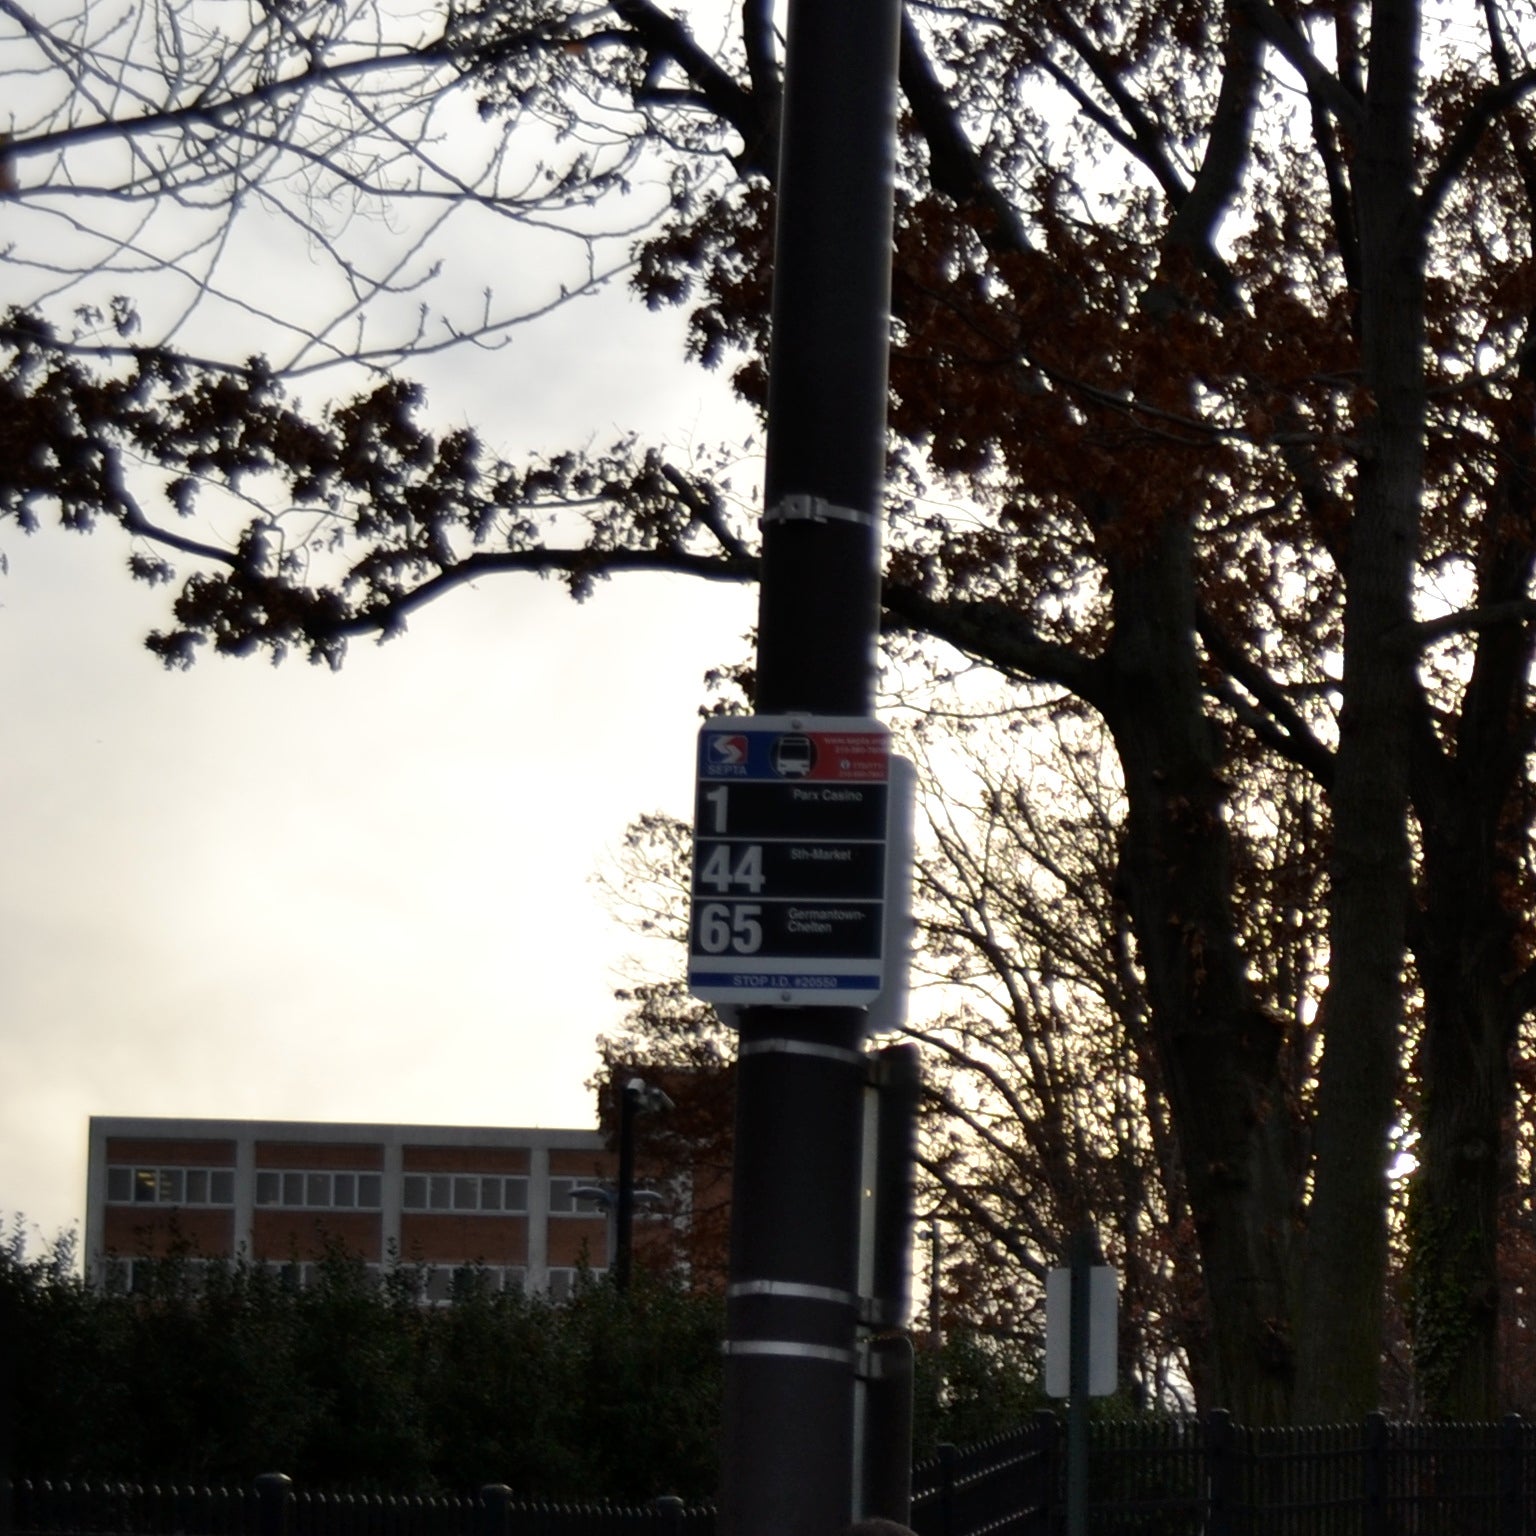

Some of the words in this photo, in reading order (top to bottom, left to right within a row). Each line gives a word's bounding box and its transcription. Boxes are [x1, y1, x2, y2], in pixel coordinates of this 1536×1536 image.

[708, 764, 747, 776] SEPTA
[706, 785, 729, 833] 1
[822, 789, 863, 801] Casino
[701, 845, 766, 893] 44
[700, 903, 763, 954] 65
[733, 975, 768, 986] STOP
